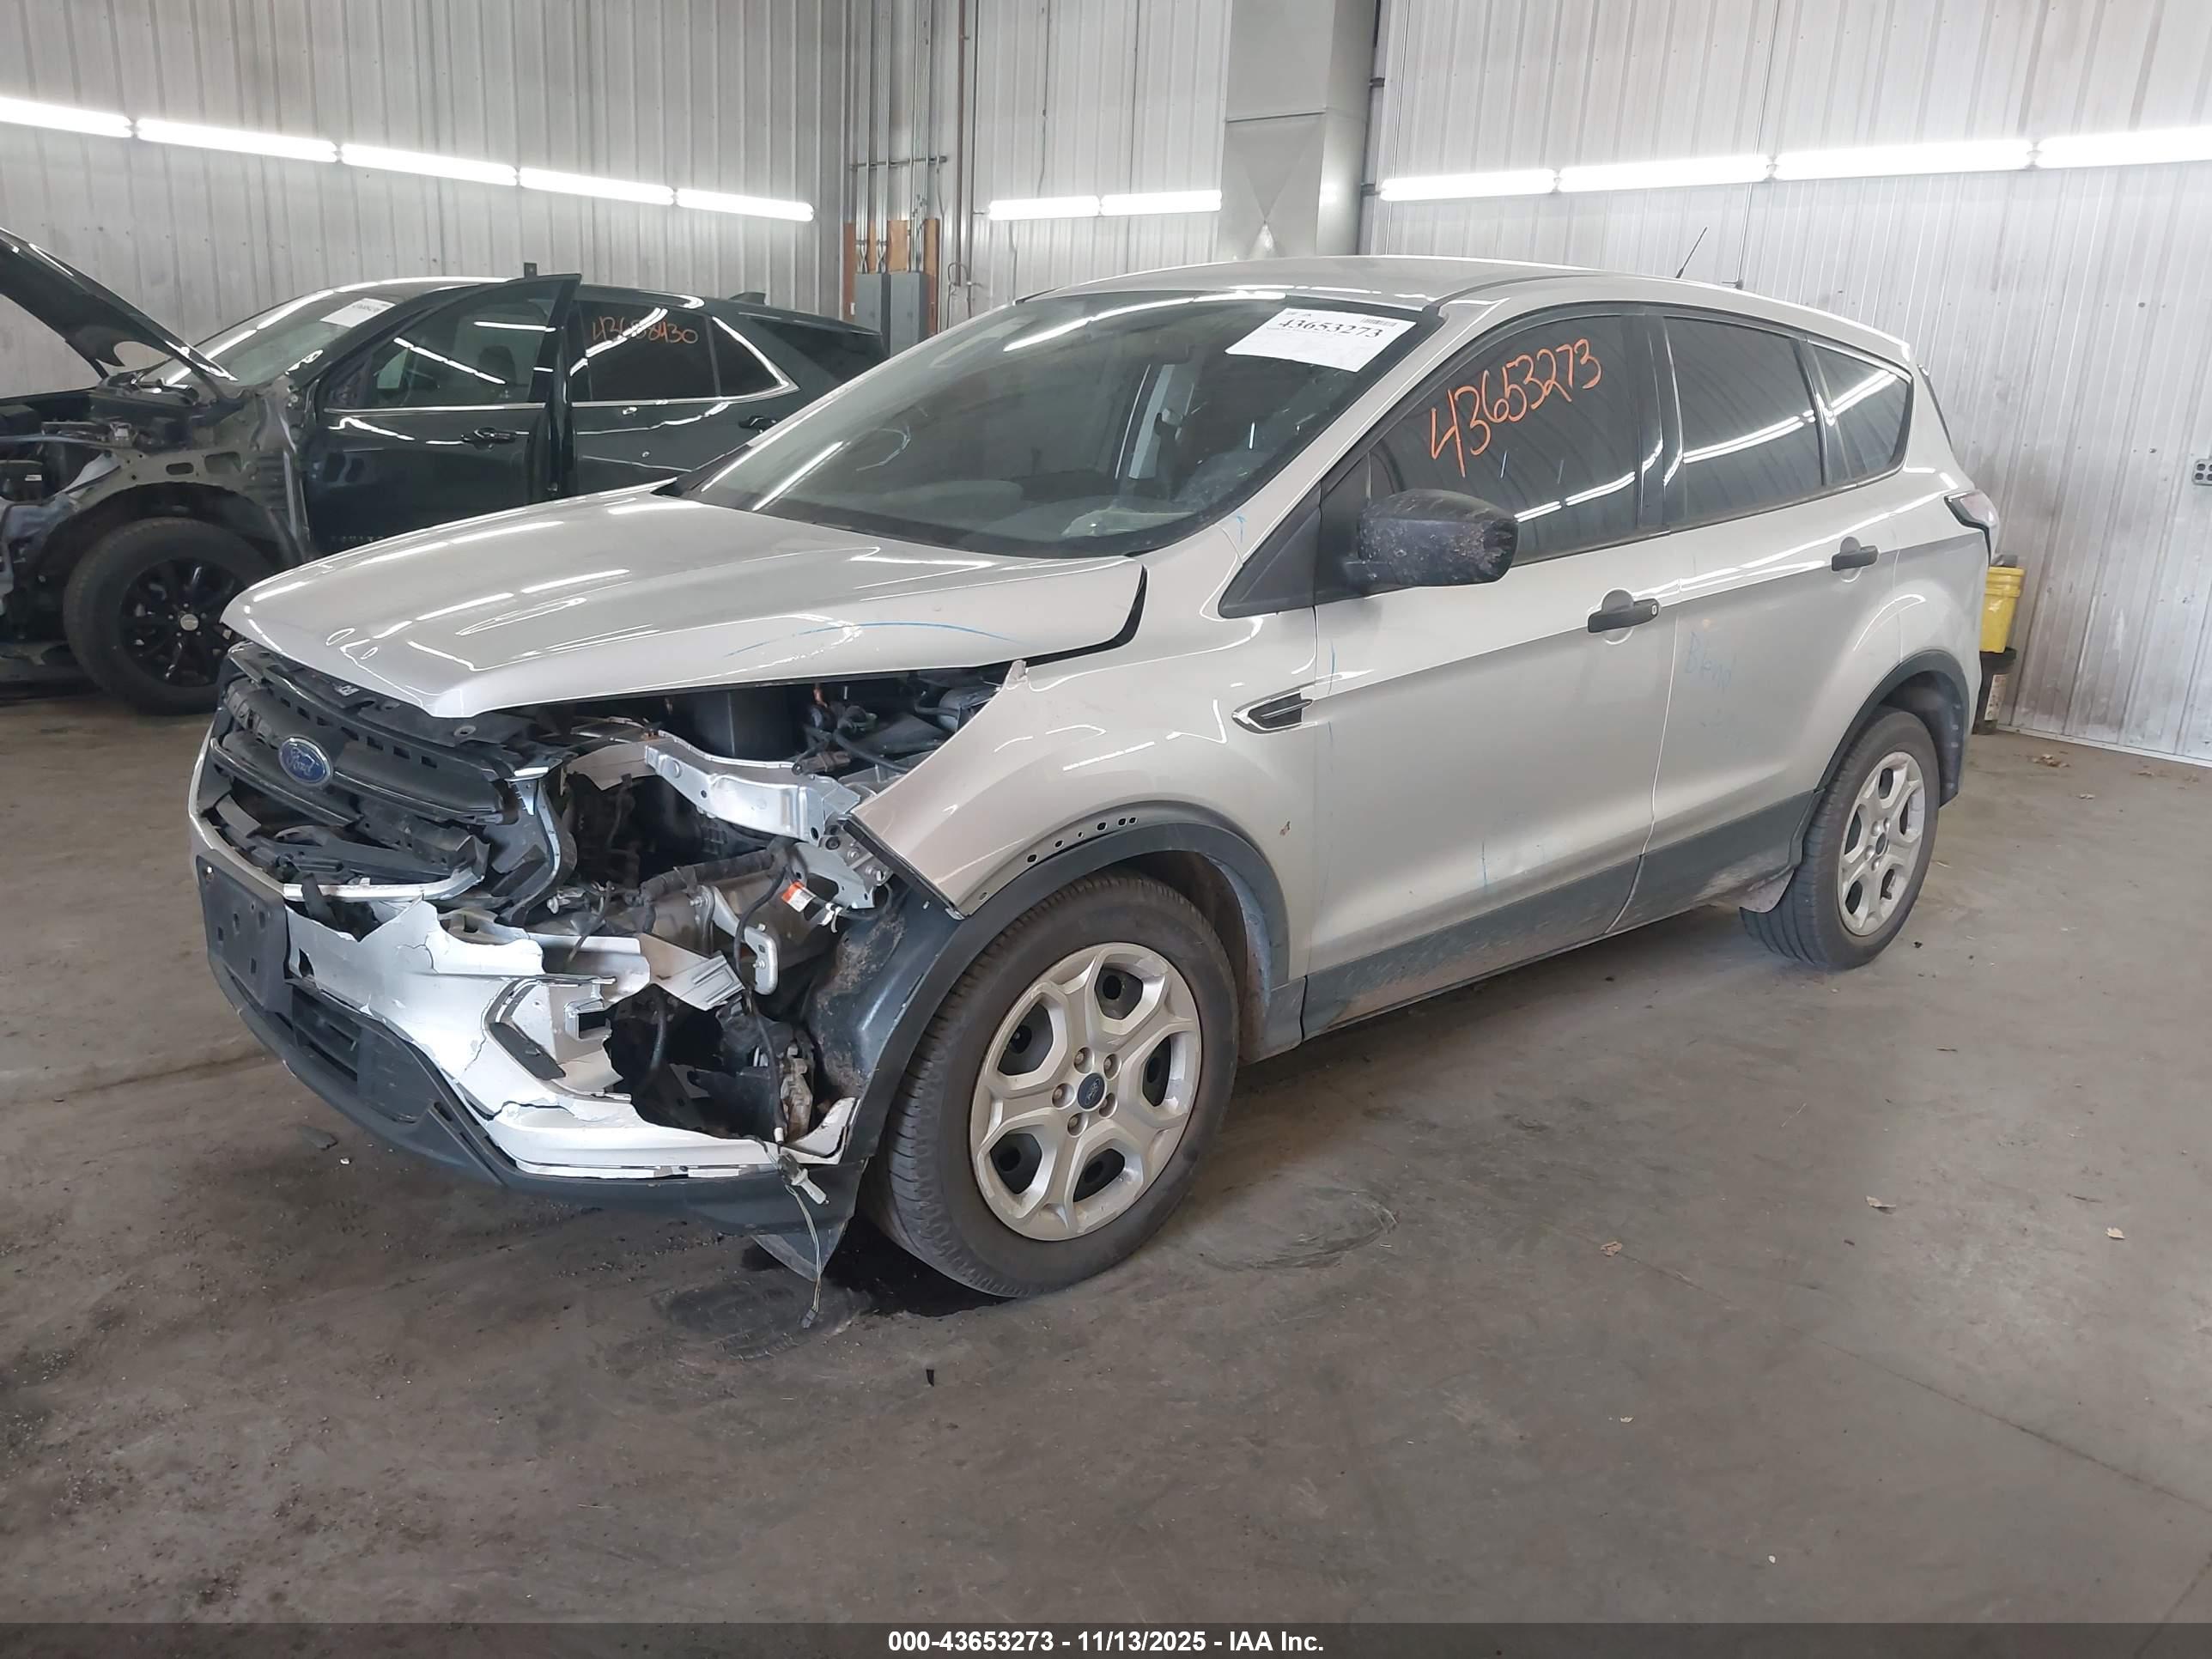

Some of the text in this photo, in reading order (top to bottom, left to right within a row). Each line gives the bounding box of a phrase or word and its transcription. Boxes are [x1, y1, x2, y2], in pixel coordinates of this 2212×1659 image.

[592, 316, 699, 344] 438430
[1279, 319, 1384, 338] 43653273
[1431, 337, 1603, 478] 43653273
